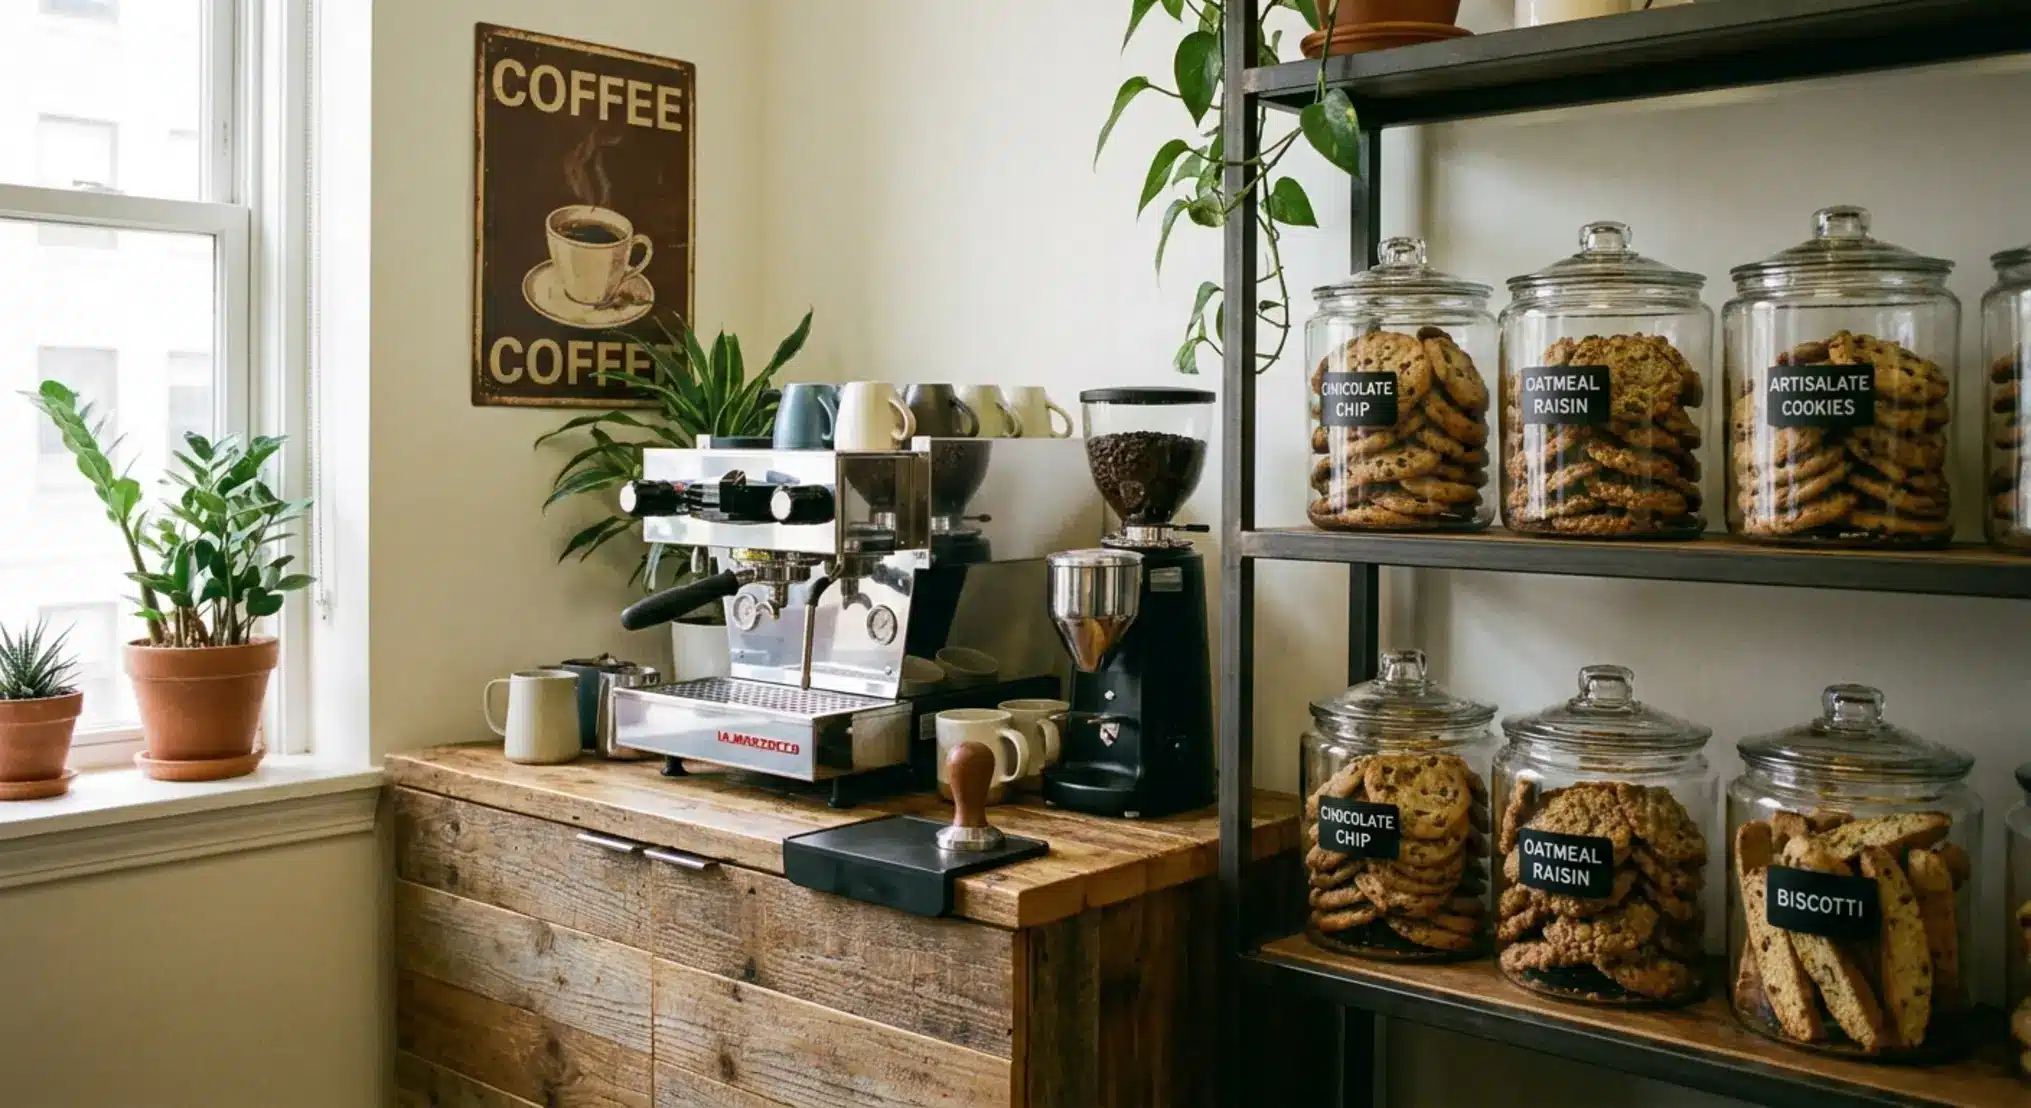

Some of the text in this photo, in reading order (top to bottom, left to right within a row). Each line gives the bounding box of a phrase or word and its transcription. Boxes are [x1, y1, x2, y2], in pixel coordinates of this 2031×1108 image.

[492, 58, 683, 132] COFFEE
[1525, 375, 1601, 392] OATMEAL
[1769, 374, 1870, 393] ARTISALATE
[1336, 402, 1370, 417] CHIP
[1533, 398, 1589, 415] RAISIN
[1782, 399, 1855, 417] COOKIES
[1335, 829, 1371, 848] CHIP
[1524, 838, 1602, 864] OATMEAL
[1532, 861, 1590, 886] RAISIN
[1777, 888, 1863, 918] BISCOTTI
